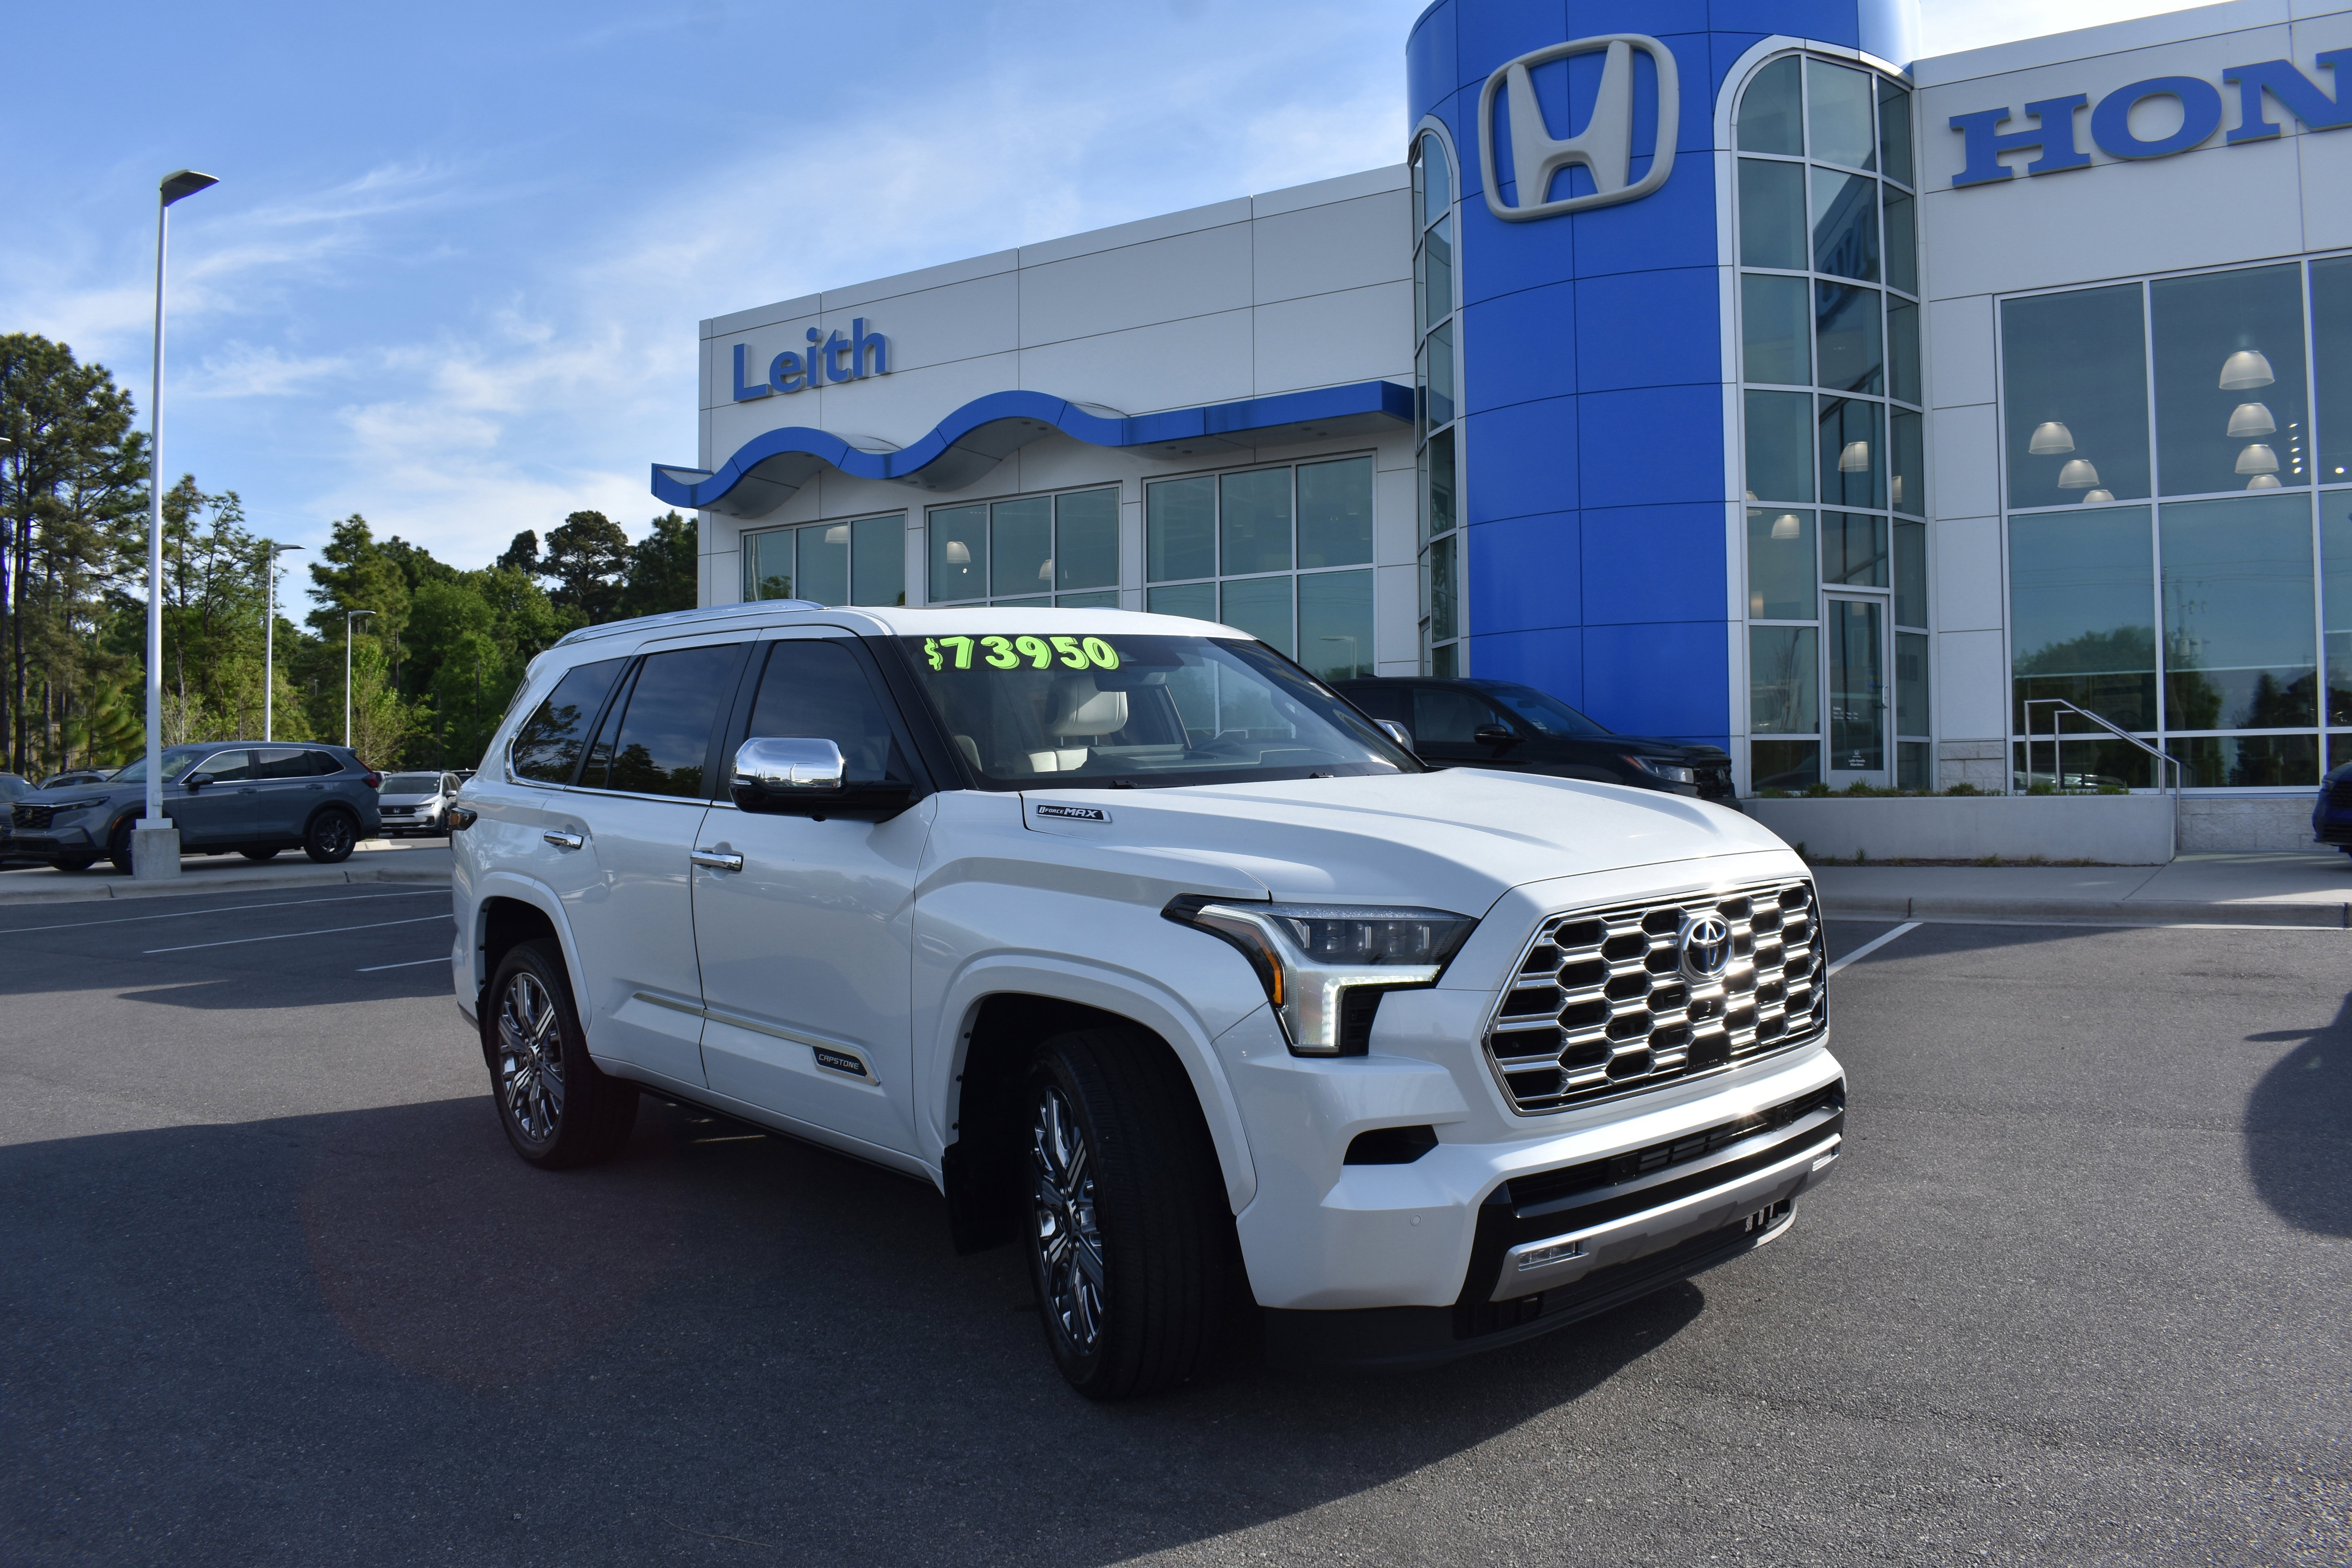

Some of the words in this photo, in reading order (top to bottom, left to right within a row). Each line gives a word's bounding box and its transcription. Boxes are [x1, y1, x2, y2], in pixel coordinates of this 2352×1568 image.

[1949, 47, 2352, 189] HON
[733, 317, 891, 403] Leith
[924, 636, 1119, 671] $73950
[819, 1054, 859, 1069] CAPSTONE
